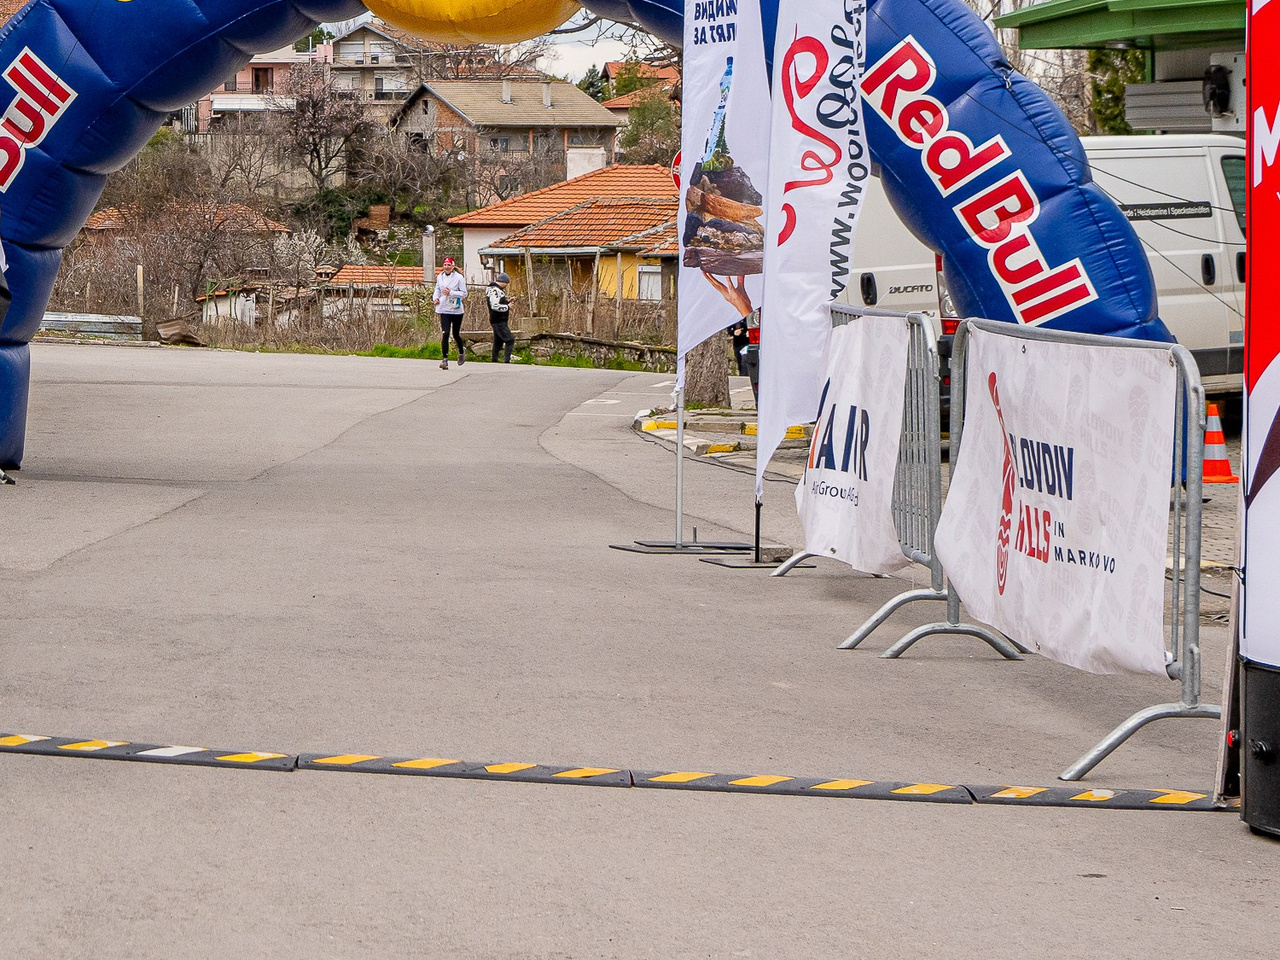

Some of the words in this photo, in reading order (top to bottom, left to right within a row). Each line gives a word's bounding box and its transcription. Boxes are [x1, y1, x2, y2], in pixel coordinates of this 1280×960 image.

[693, 25, 708, 45] ЗА
[709, 22, 738, 44] ТЯЛ
[859, 38, 1008, 194] Red
[957, 174, 1095, 326] Bull
[889, 284, 933, 295] DUCATO
[1053, 520, 1065, 538] IN
[1053, 546, 1116, 574] MARKOVO
